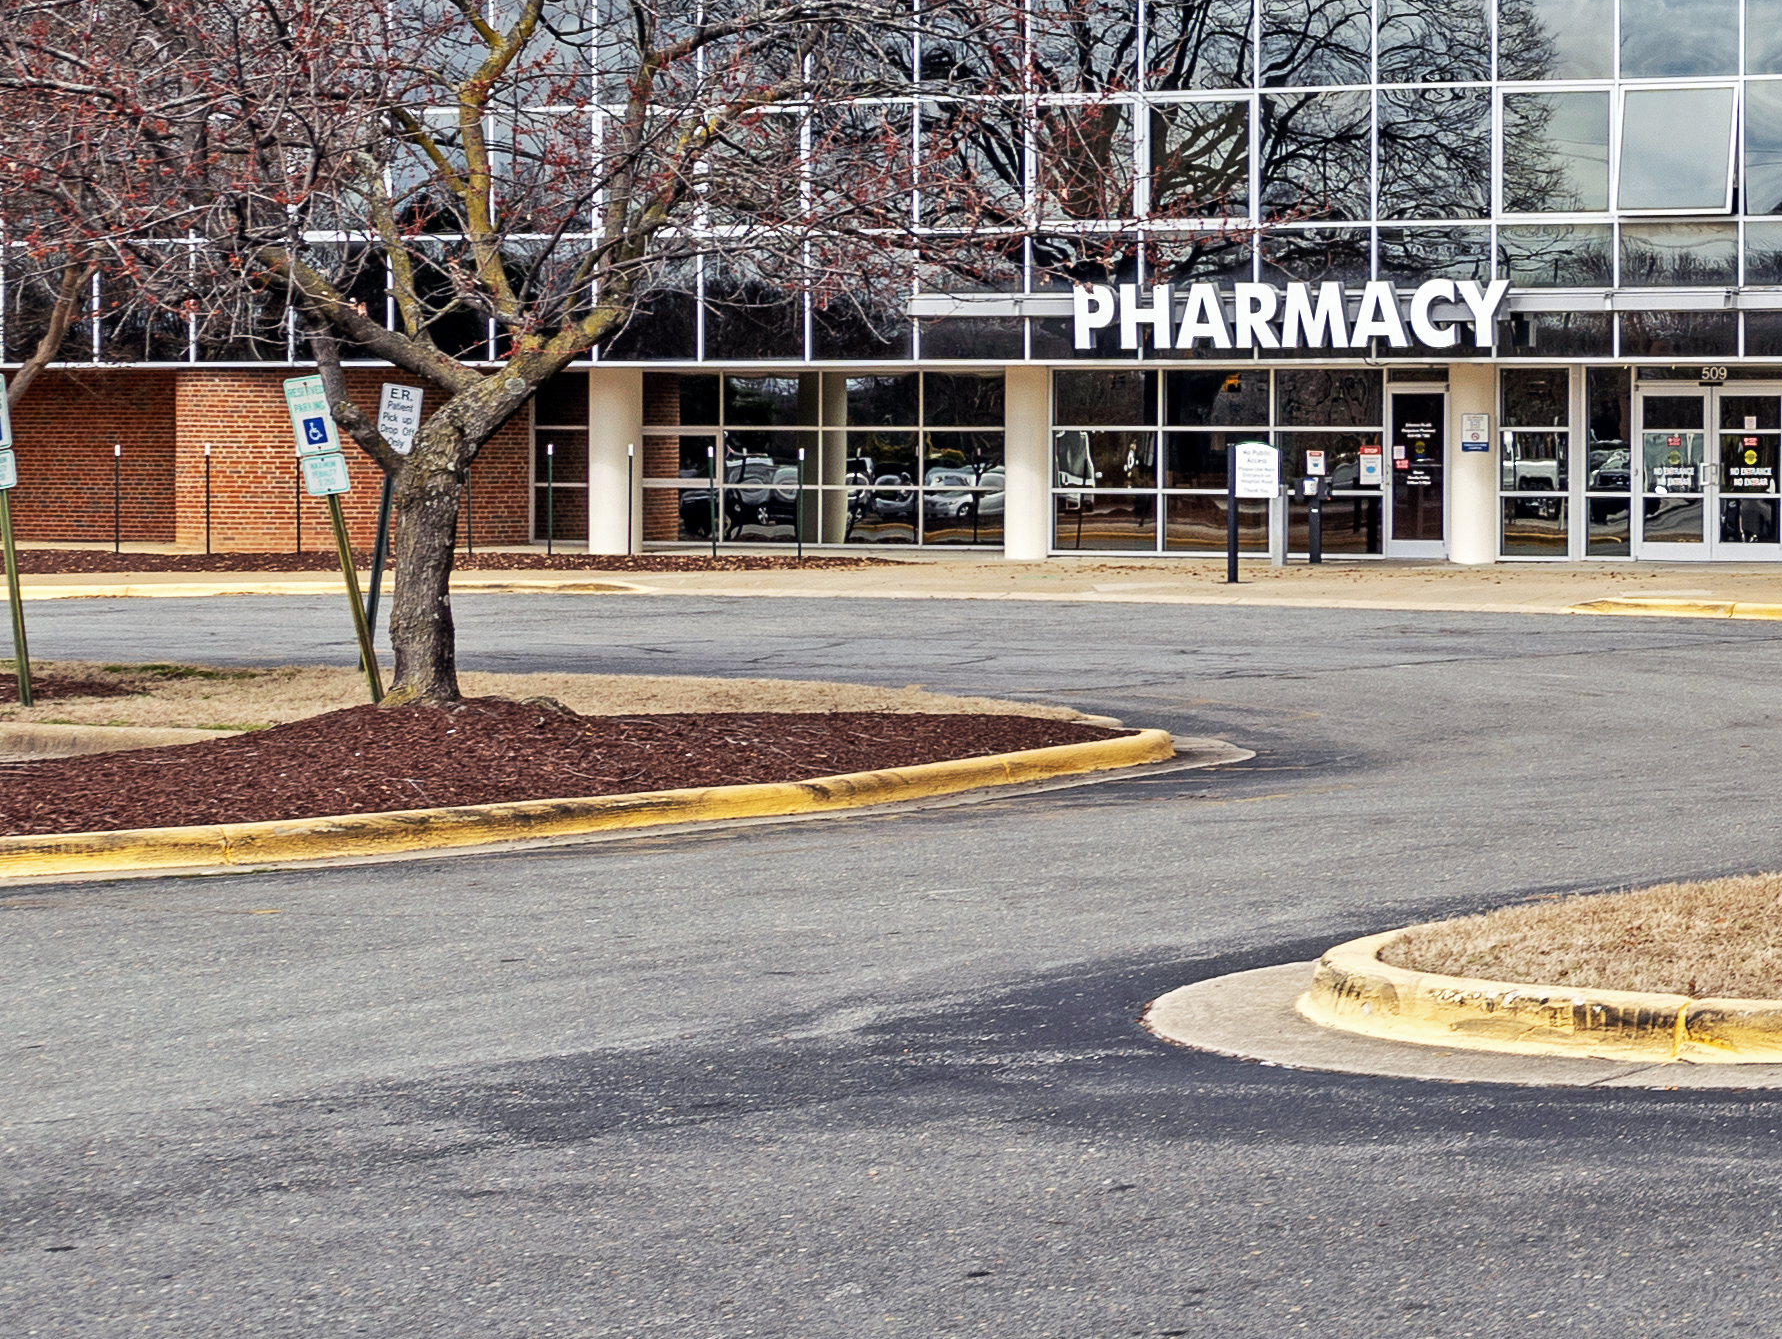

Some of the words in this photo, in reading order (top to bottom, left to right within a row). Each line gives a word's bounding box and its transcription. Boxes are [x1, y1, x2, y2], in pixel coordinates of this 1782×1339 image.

[1073, 278, 1510, 349] PHARMACY
[1701, 367, 1727, 379] 509
[391, 388, 413, 401] E.R.
[388, 401, 413, 412] Patient
[383, 412, 398, 422] Pick
[381, 424, 398, 435] Drop
[388, 437, 404, 448] Only
[1730, 468, 1739, 476] NO
